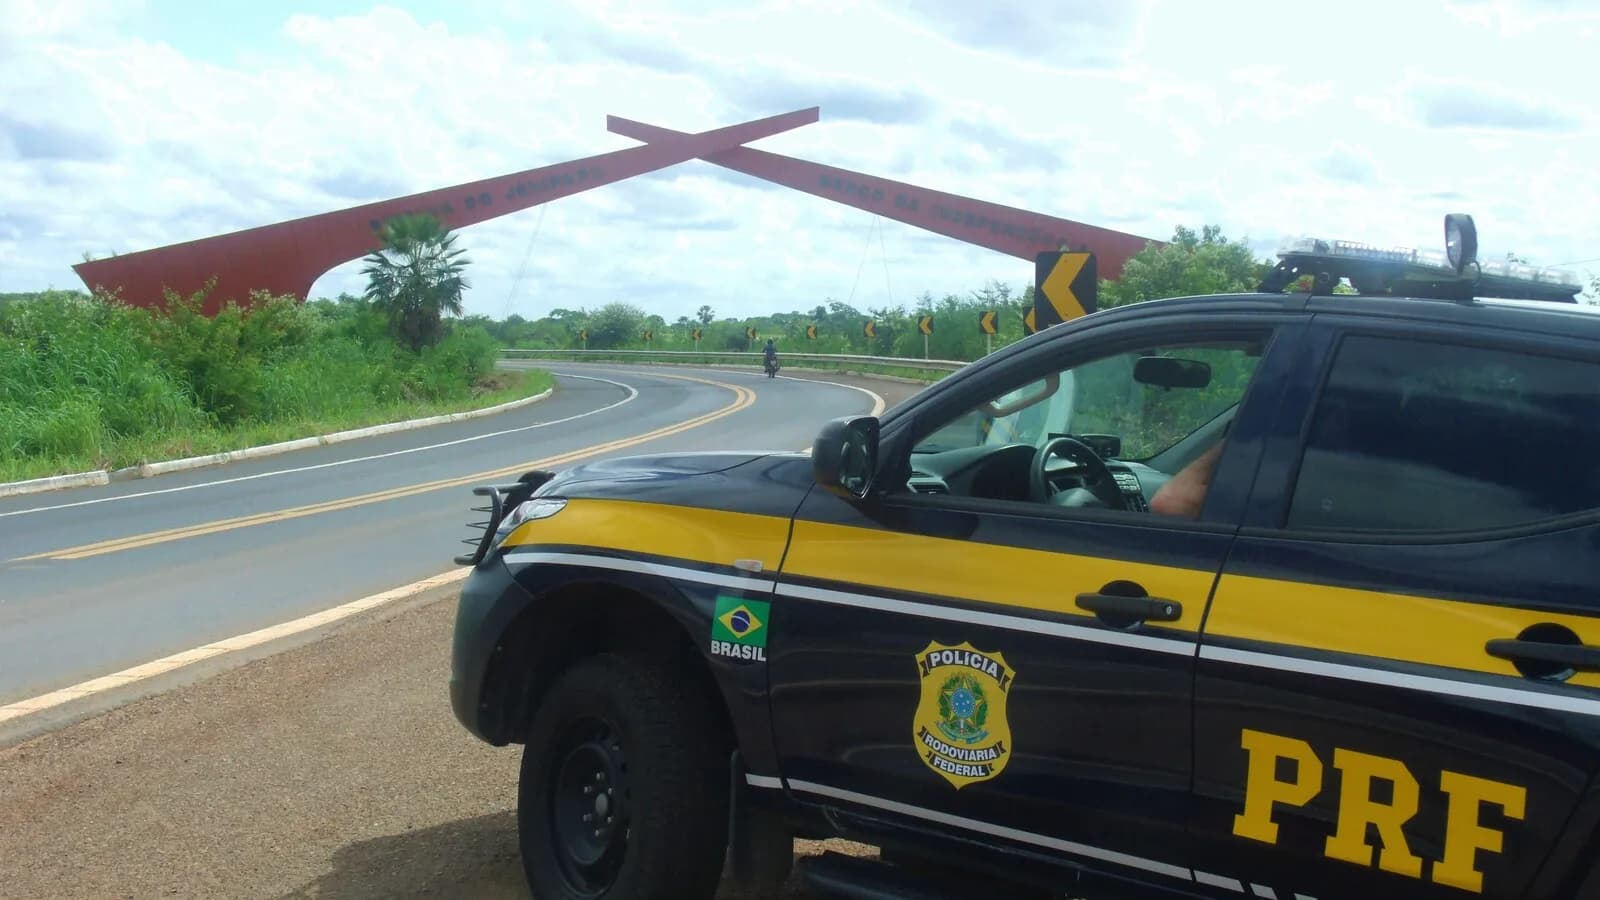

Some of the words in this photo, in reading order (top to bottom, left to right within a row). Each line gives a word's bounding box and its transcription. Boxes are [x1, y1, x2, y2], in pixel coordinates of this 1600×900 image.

[711, 640, 767, 662] BRASIL
[930, 649, 998, 678] POLÍCIA
[933, 756, 986, 777] FEDERAL
[1232, 728, 1528, 894] PRF
